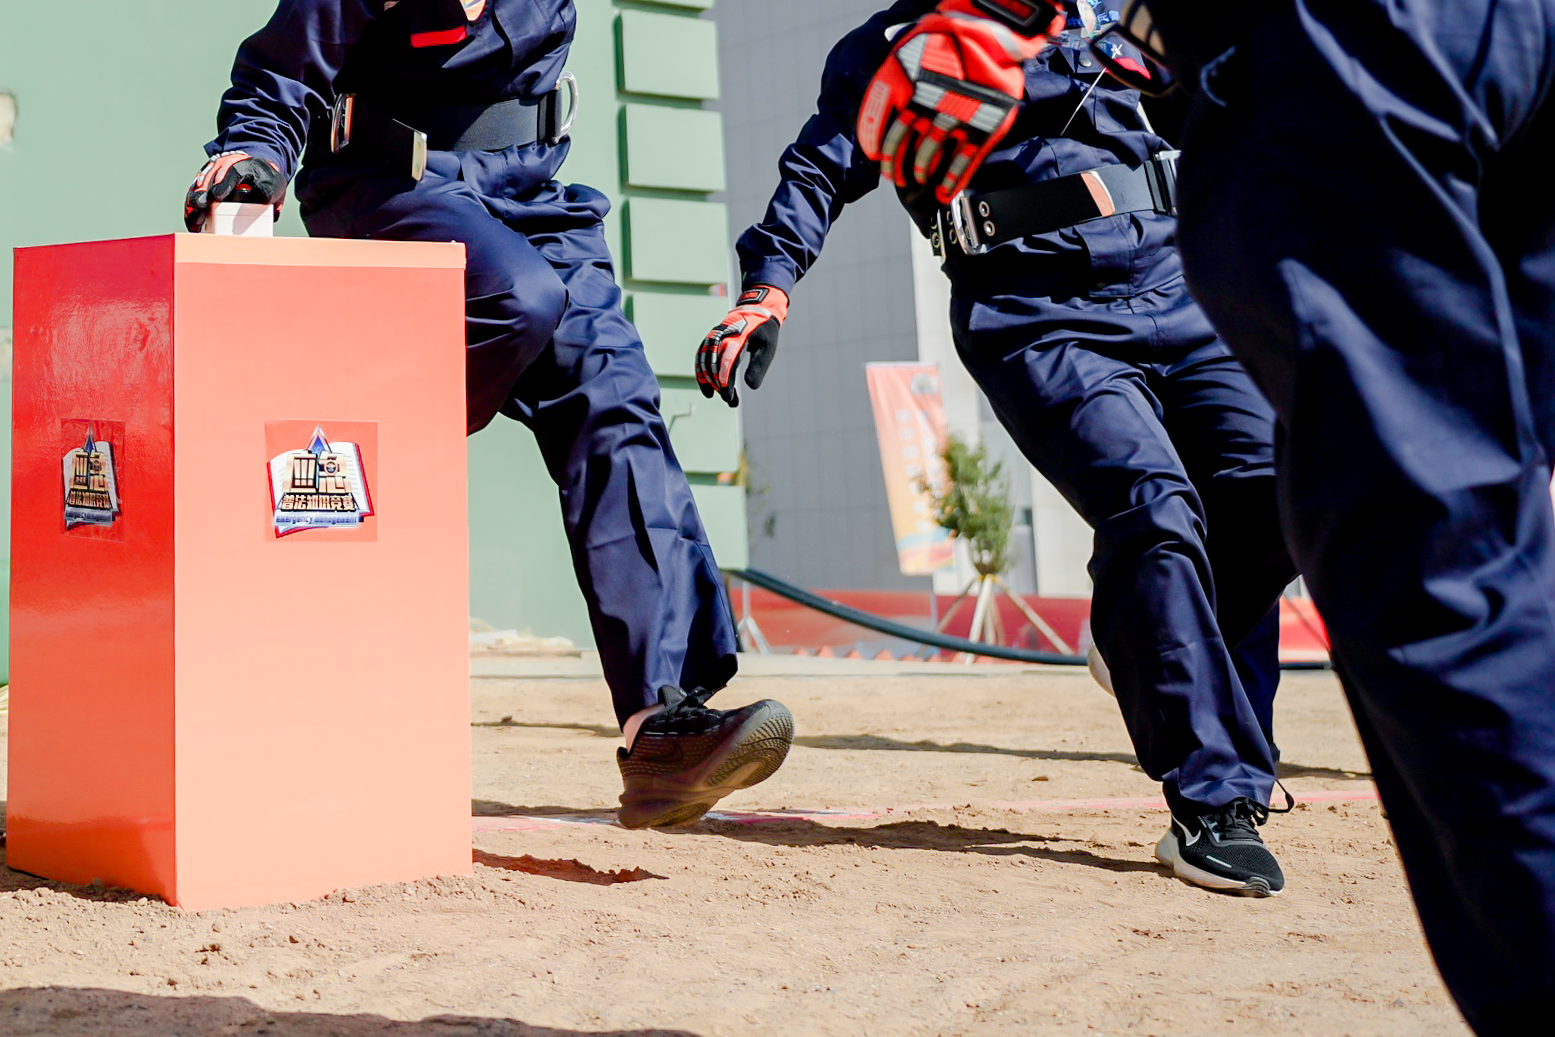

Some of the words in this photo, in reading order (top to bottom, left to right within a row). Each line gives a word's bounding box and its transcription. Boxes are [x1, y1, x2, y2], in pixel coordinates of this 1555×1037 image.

[281, 494, 356, 511] 普法知识竞赛
